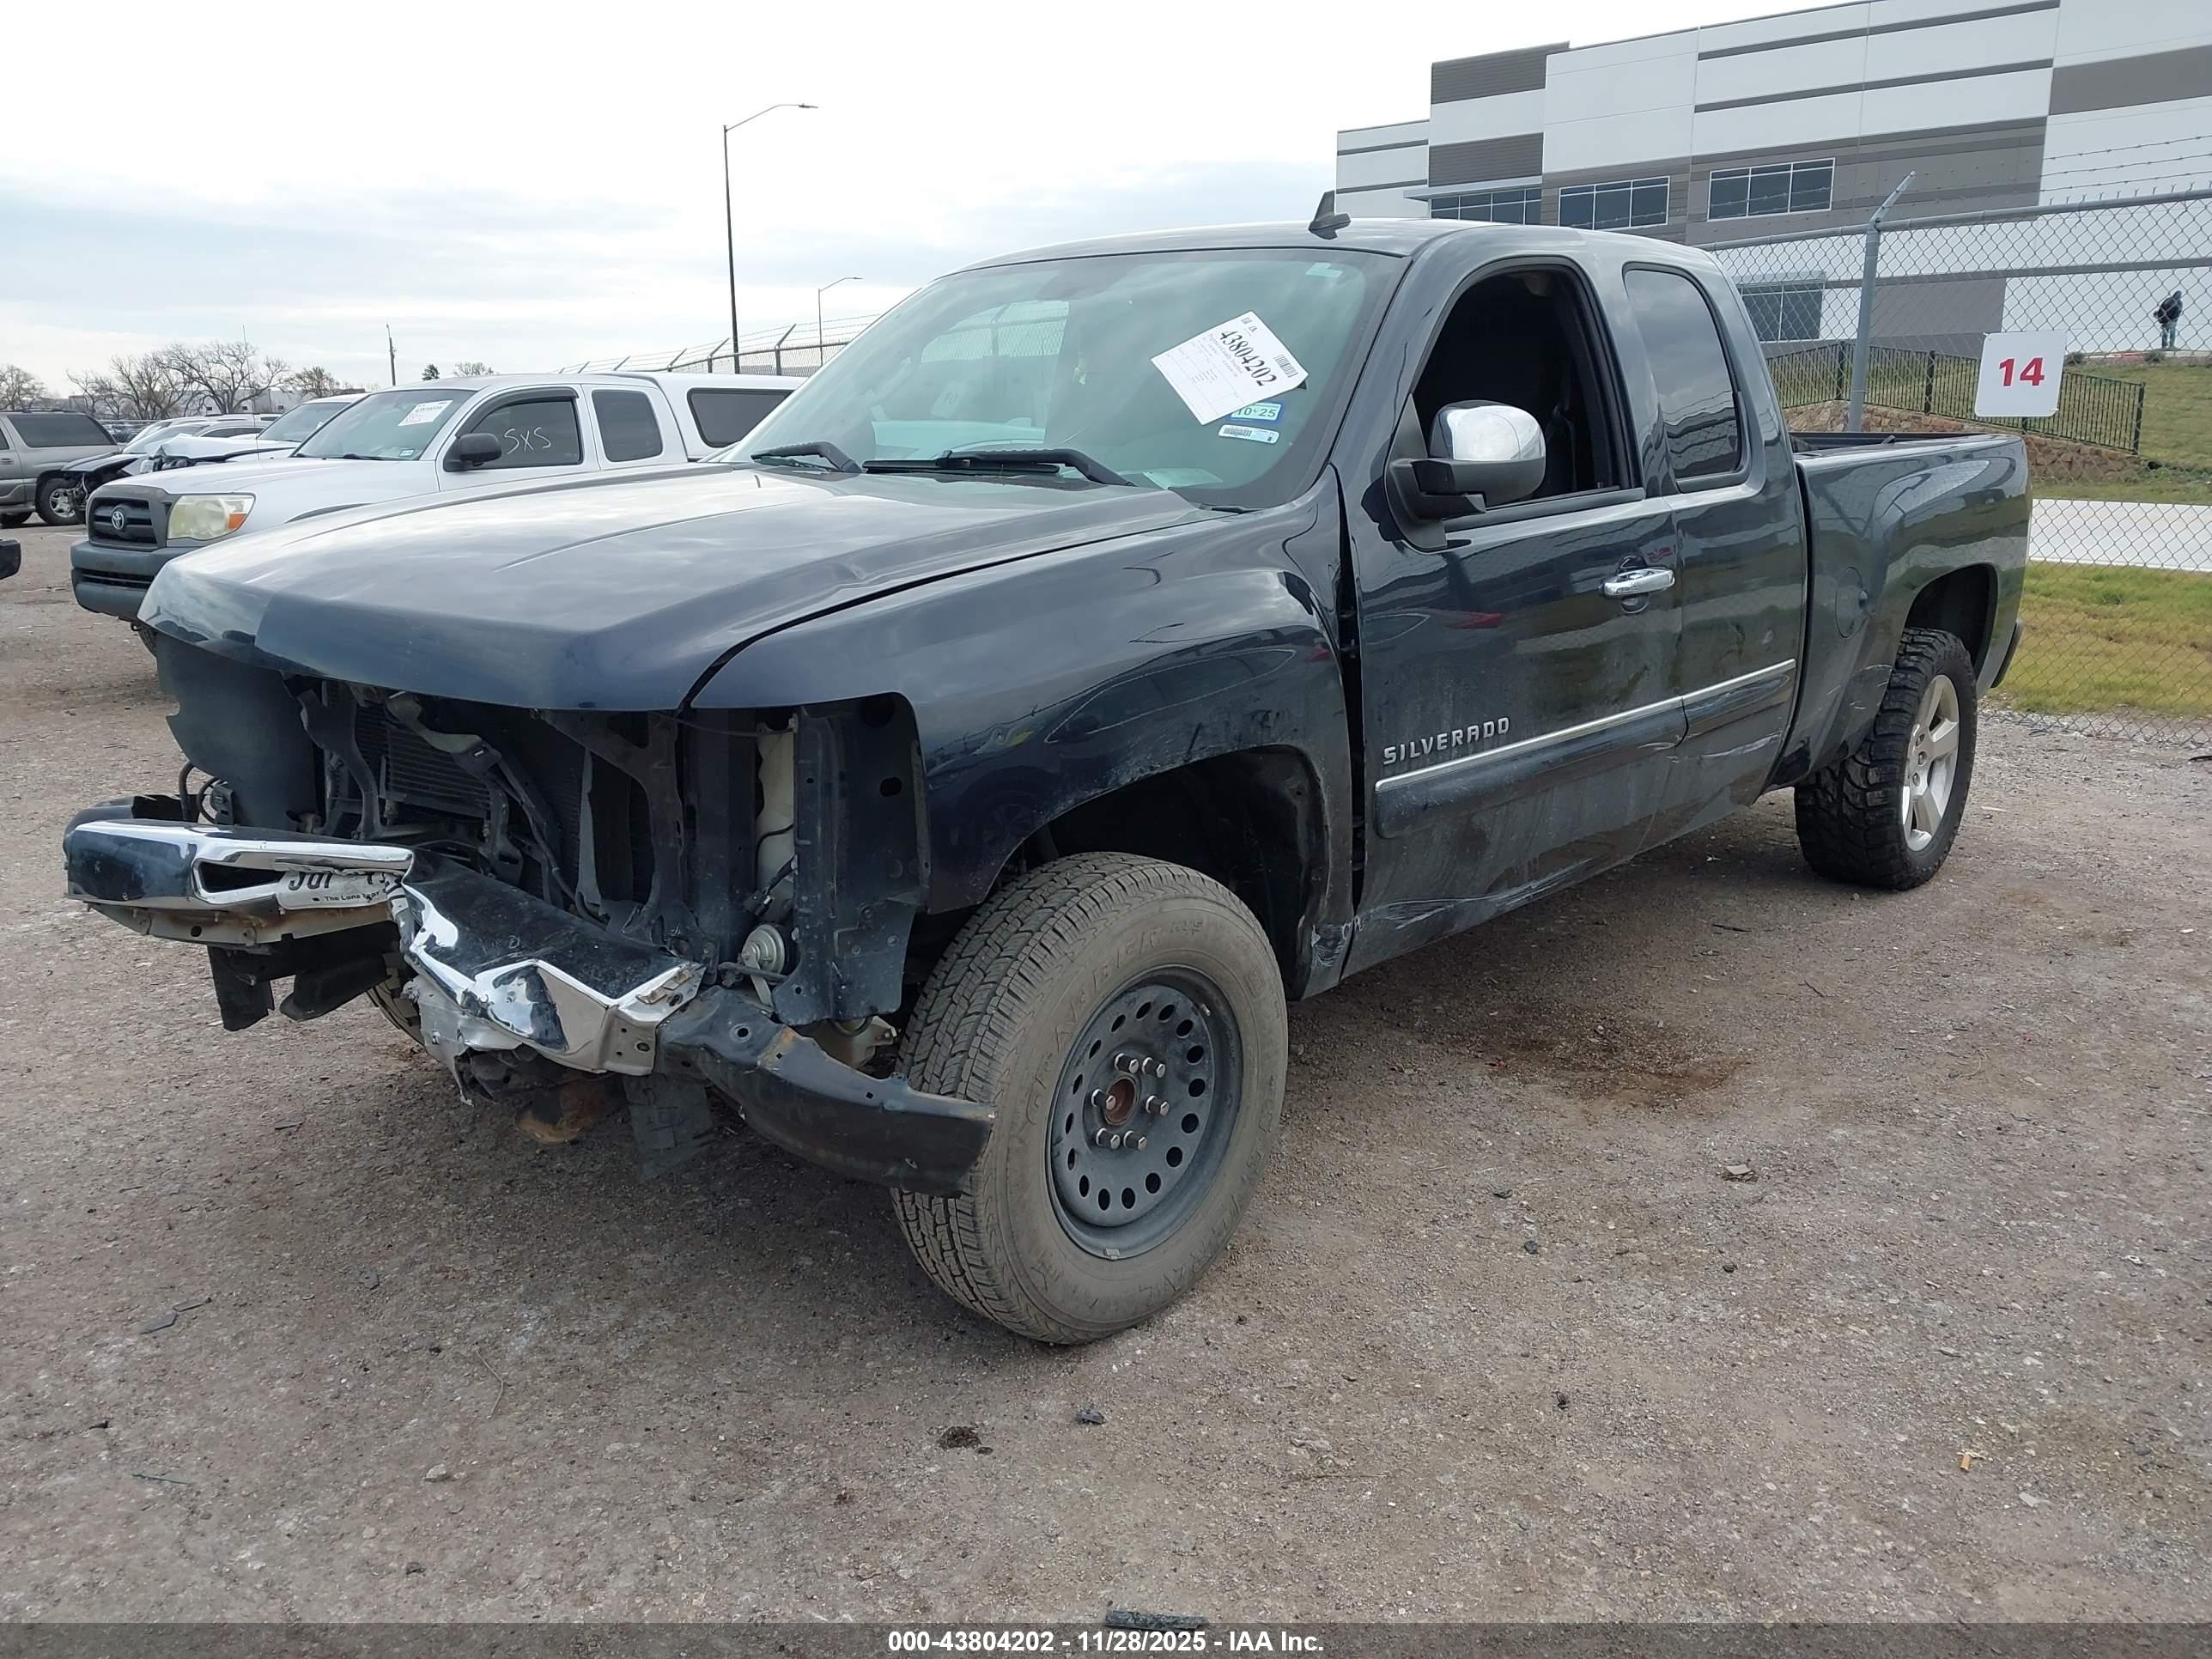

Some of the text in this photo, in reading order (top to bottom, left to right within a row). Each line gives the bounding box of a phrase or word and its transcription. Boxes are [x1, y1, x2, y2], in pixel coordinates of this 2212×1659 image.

[1220, 331, 1277, 386] 43804202
[1999, 357, 2045, 386] 14
[1259, 408, 1277, 418] 25
[1383, 717, 1510, 765] SILVERADO
